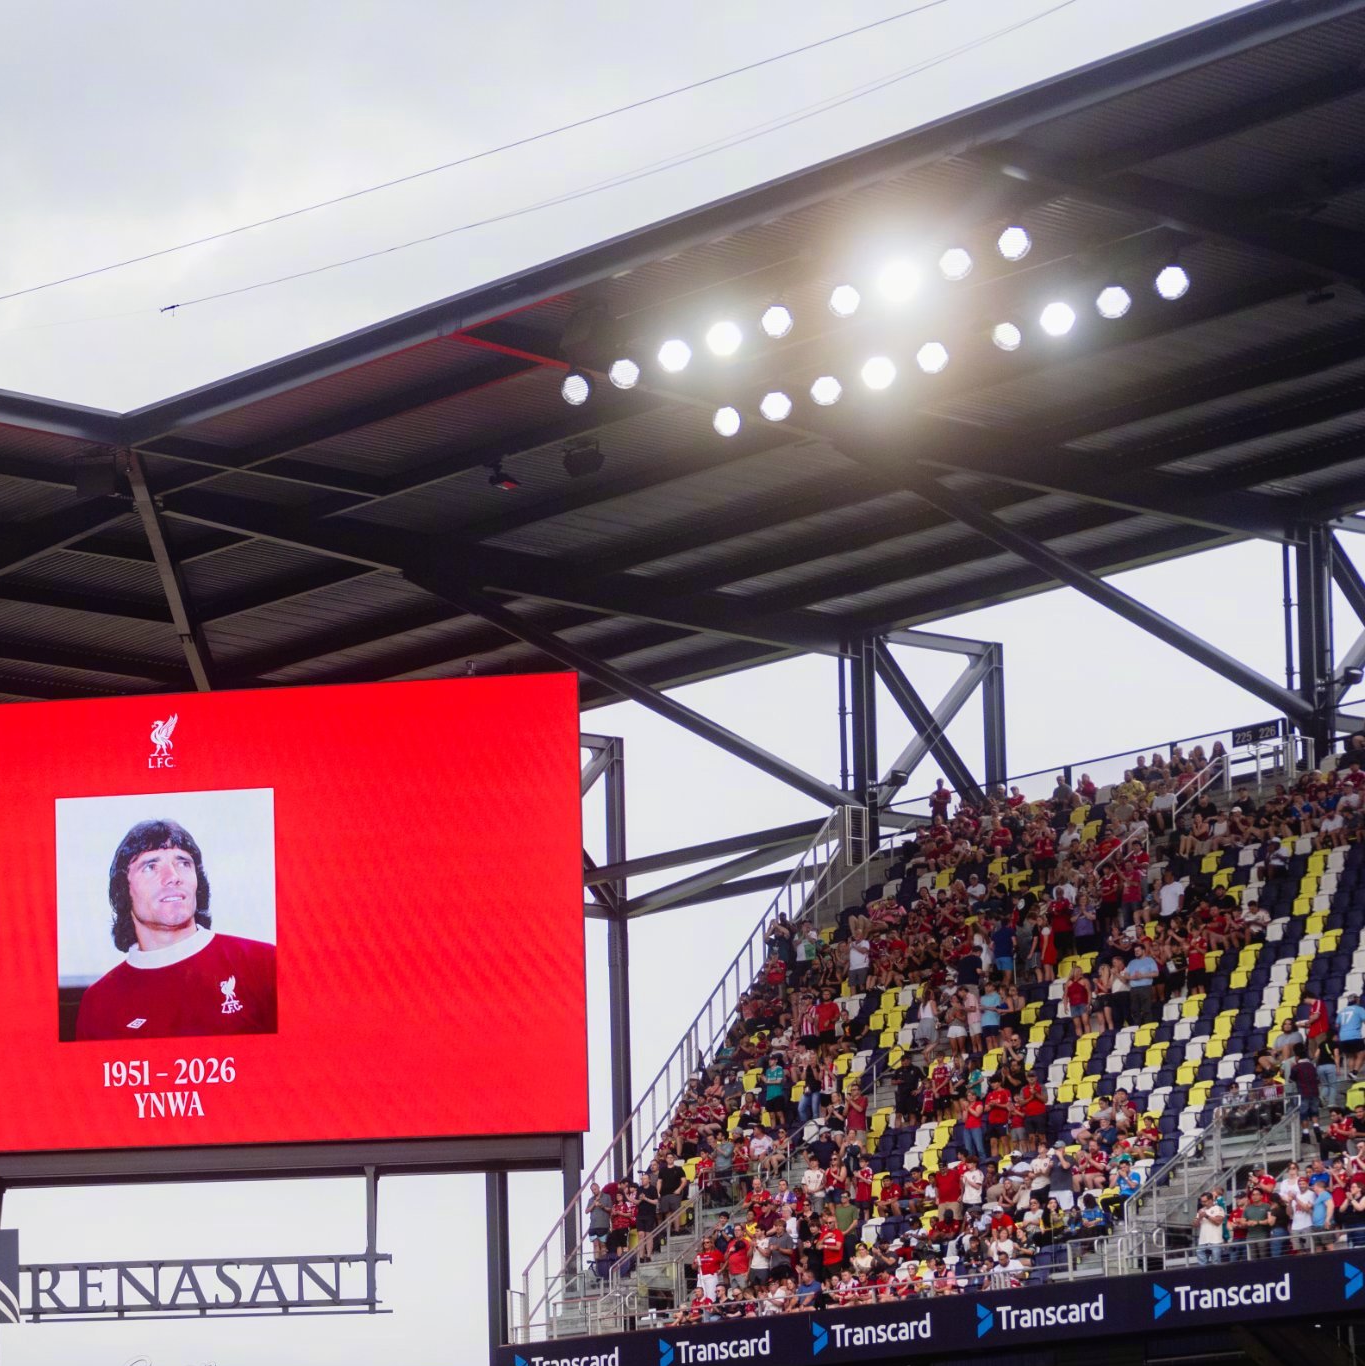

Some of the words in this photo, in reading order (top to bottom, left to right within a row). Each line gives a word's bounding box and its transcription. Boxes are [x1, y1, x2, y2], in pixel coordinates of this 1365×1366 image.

[1235, 732, 1252, 744] 225
[1259, 725, 1276, 738] 226
[103, 1060, 149, 1086] 1951
[173, 1057, 236, 1085] 2026
[134, 1091, 205, 1118] YNWA
[27, 1256, 391, 1313] RENASANT
[1174, 1273, 1289, 1311] Transcard
[996, 1294, 1104, 1330] Transcard
[676, 1330, 770, 1364] Transcard
[831, 1312, 931, 1348] Transcard
